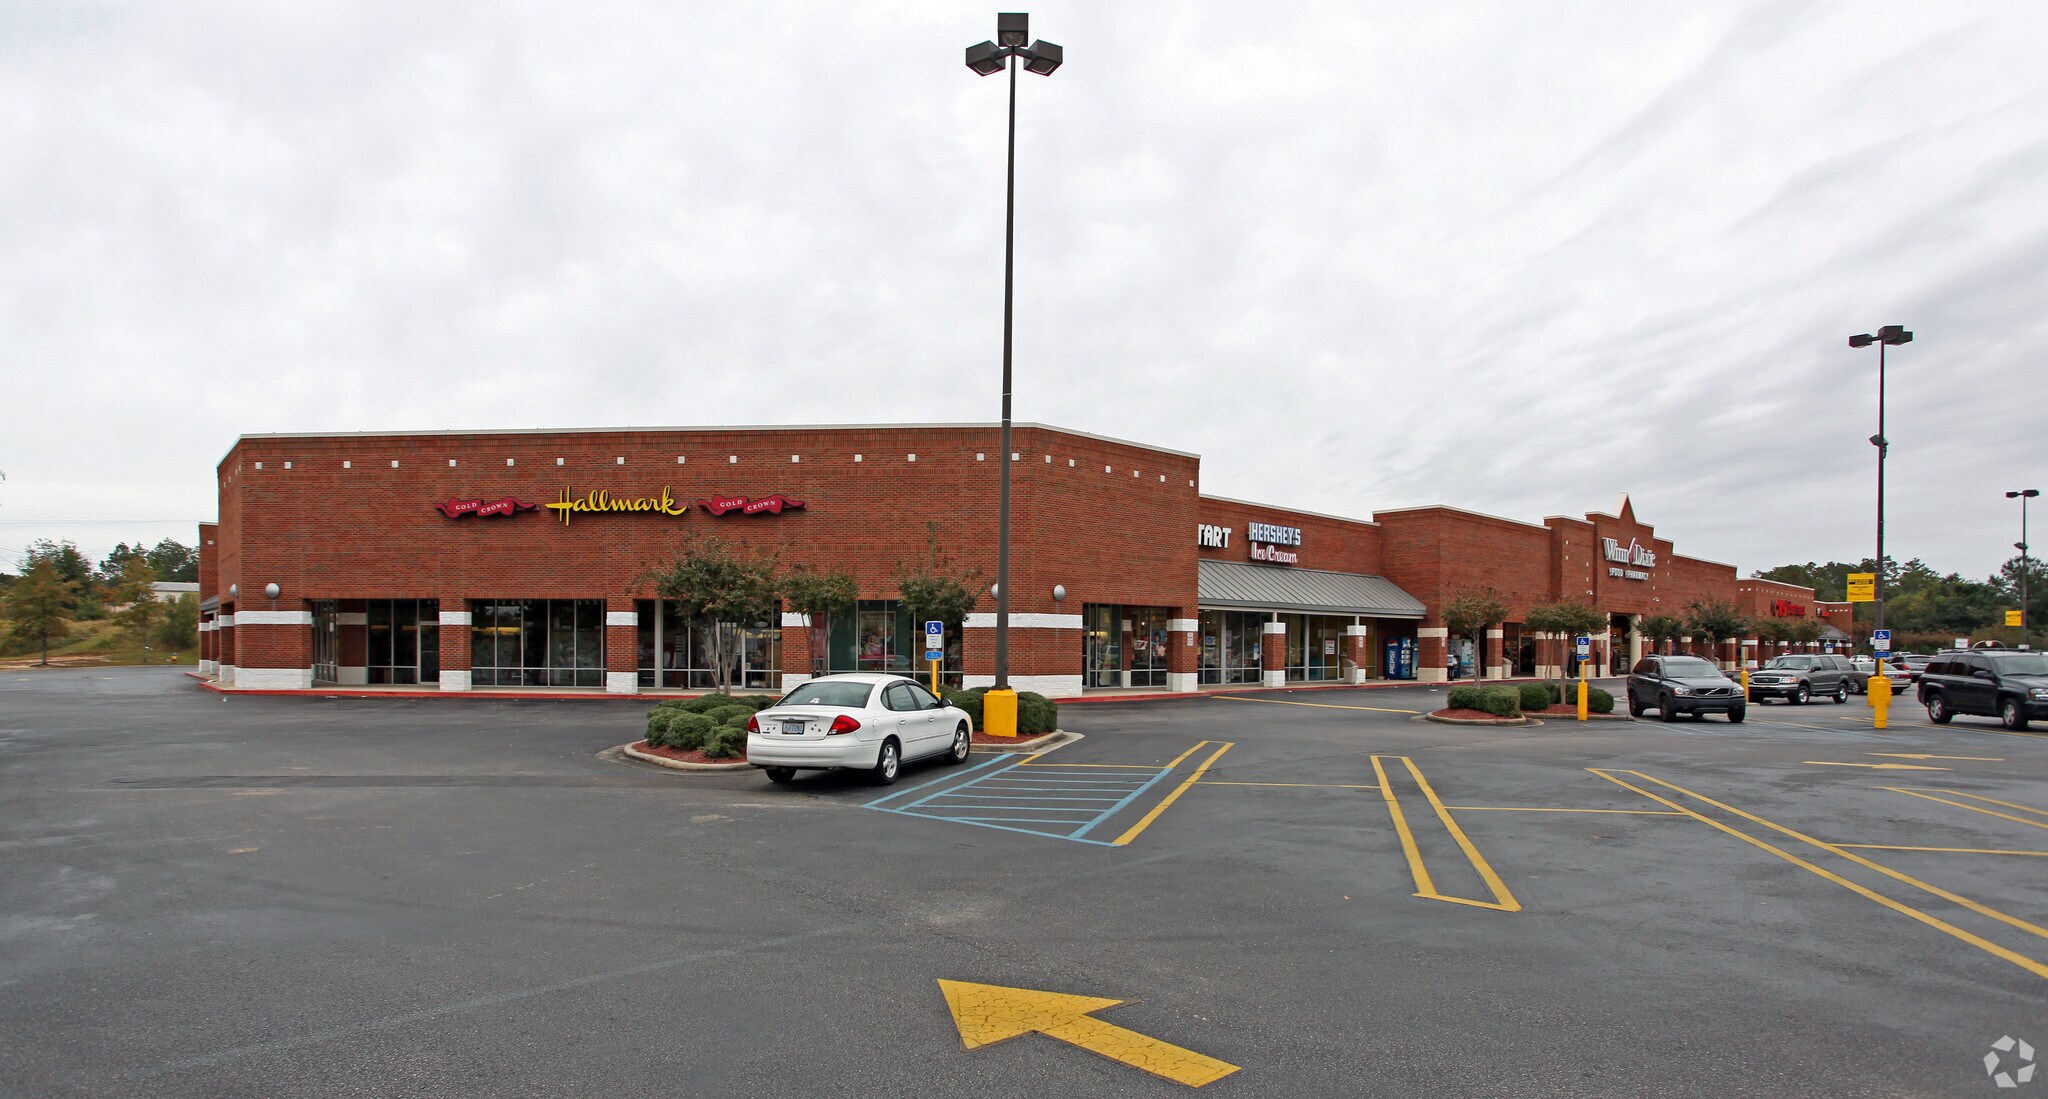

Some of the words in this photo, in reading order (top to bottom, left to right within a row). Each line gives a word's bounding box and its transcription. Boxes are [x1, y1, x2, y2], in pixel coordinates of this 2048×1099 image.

[455, 502, 477, 510] GOLD
[481, 502, 508, 513] CROWN
[545, 485, 687, 526] Hallmark
[720, 500, 743, 508] GOLD
[747, 500, 776, 511] CROWN
[1252, 542, 1267, 560] Ice
[1266, 545, 1298, 563] Cream
